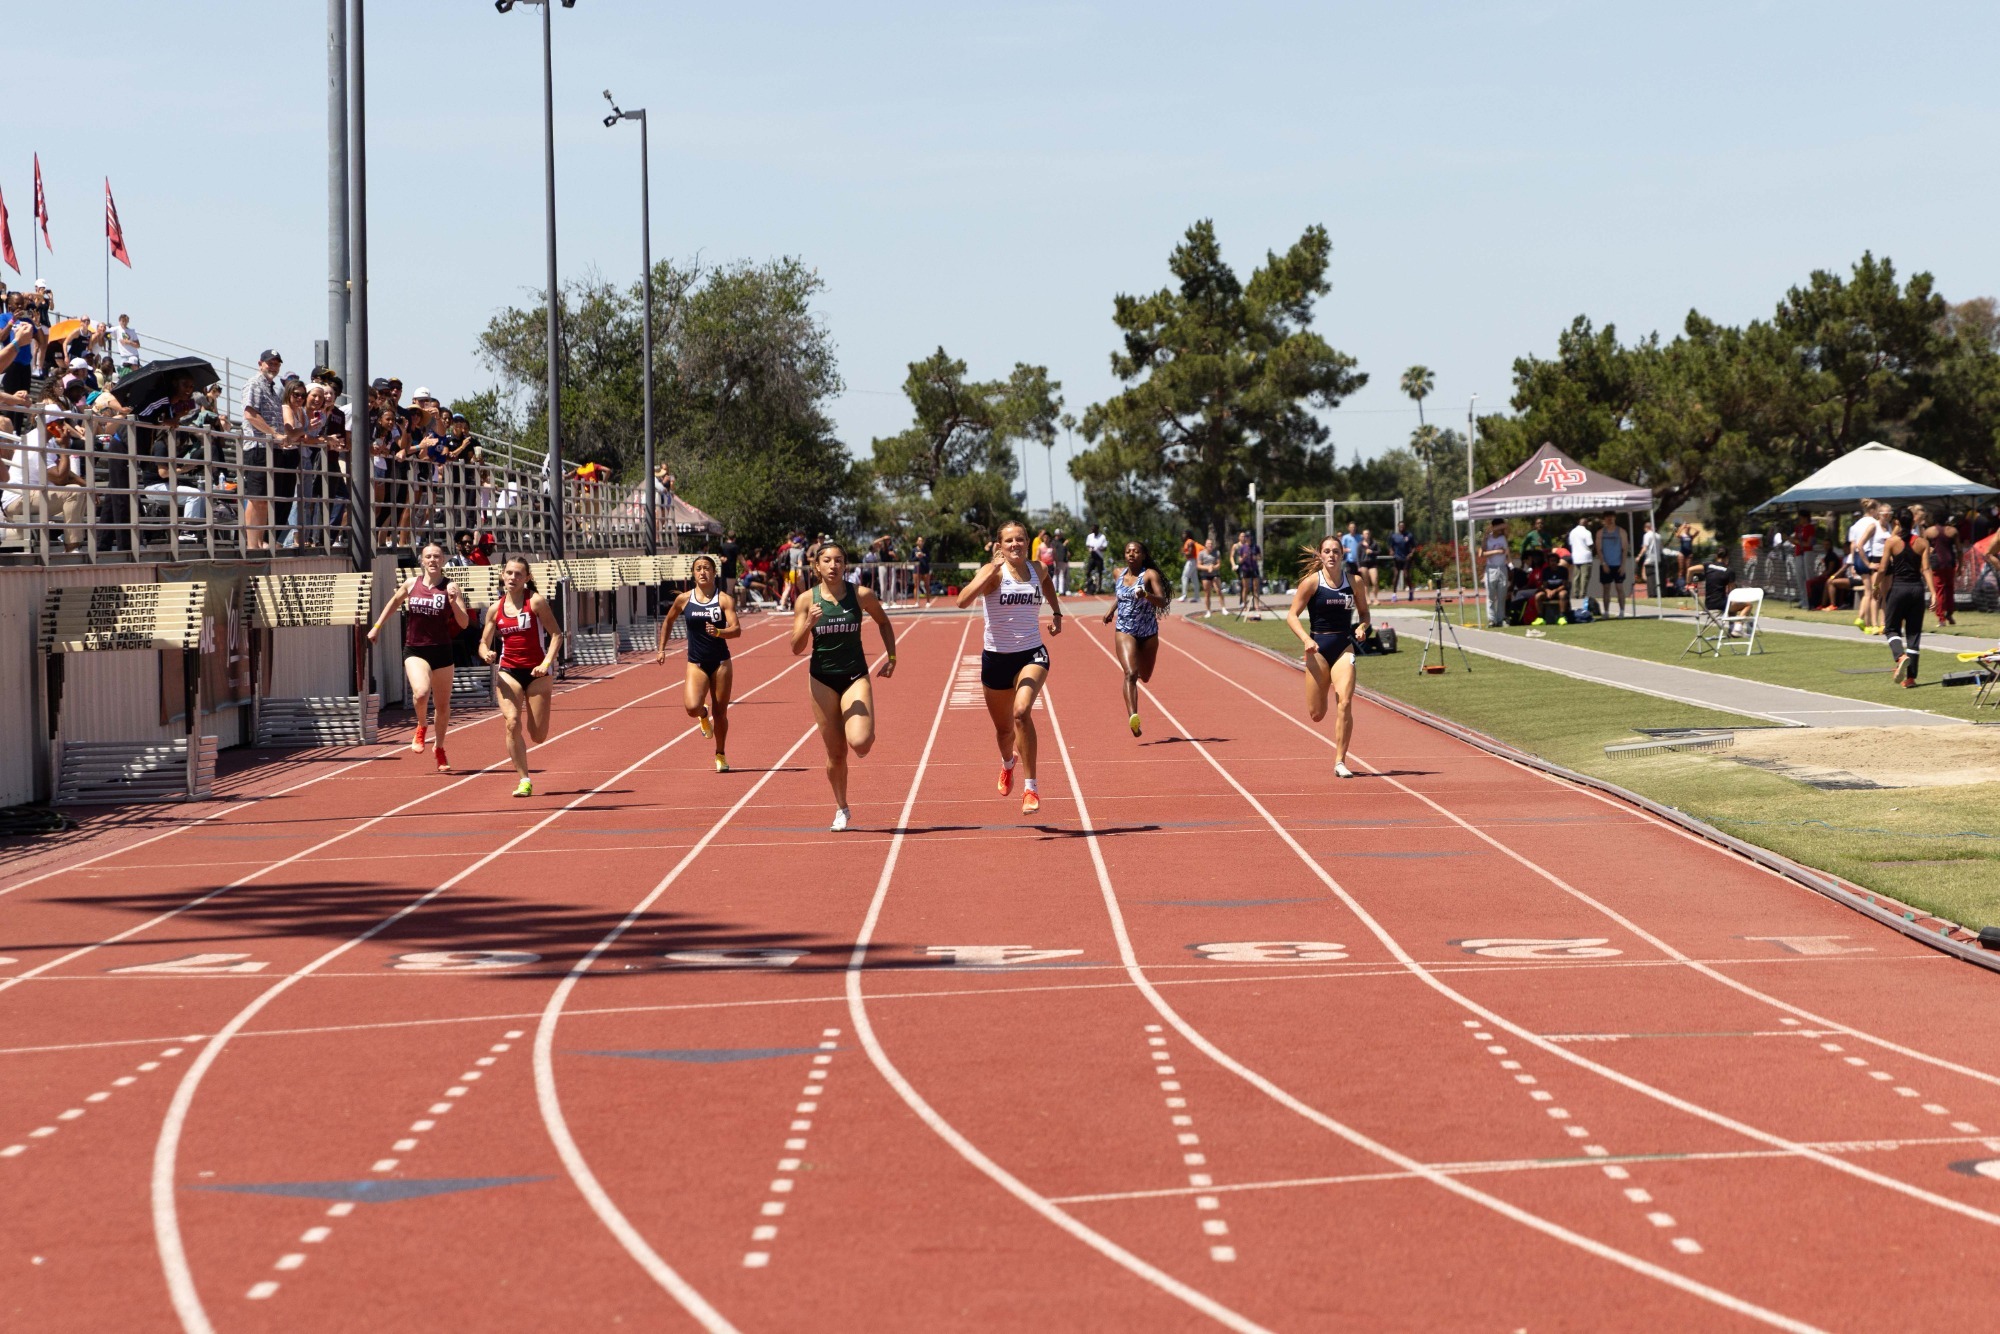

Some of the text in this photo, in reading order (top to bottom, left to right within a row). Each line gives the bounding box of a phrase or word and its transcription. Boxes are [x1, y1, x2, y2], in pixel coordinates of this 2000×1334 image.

[1495, 494, 1627, 515] CROSS COUNTRY
[126, 585, 161, 593] PACIFIC
[1034, 585, 1042, 603] 4
[436, 596, 443, 608] 8
[1348, 596, 1354, 608] 2
[411, 606, 440, 616] PACIFIC
[713, 608, 720, 620] 6
[520, 614, 527, 628] 7
[816, 623, 859, 635] HUMBOLDT
[83, 640, 151, 650] AZUSA PACIFIC
[85, 633, 114, 641] AZUSA
[1193, 941, 1350, 962] 3
[1459, 937, 1624, 959] 2
[1743, 935, 1878, 955] 1
[393, 950, 541, 970] 6
[659, 948, 811, 967] 5
[925, 944, 1084, 964] 4
[107, 953, 271, 973] 7
